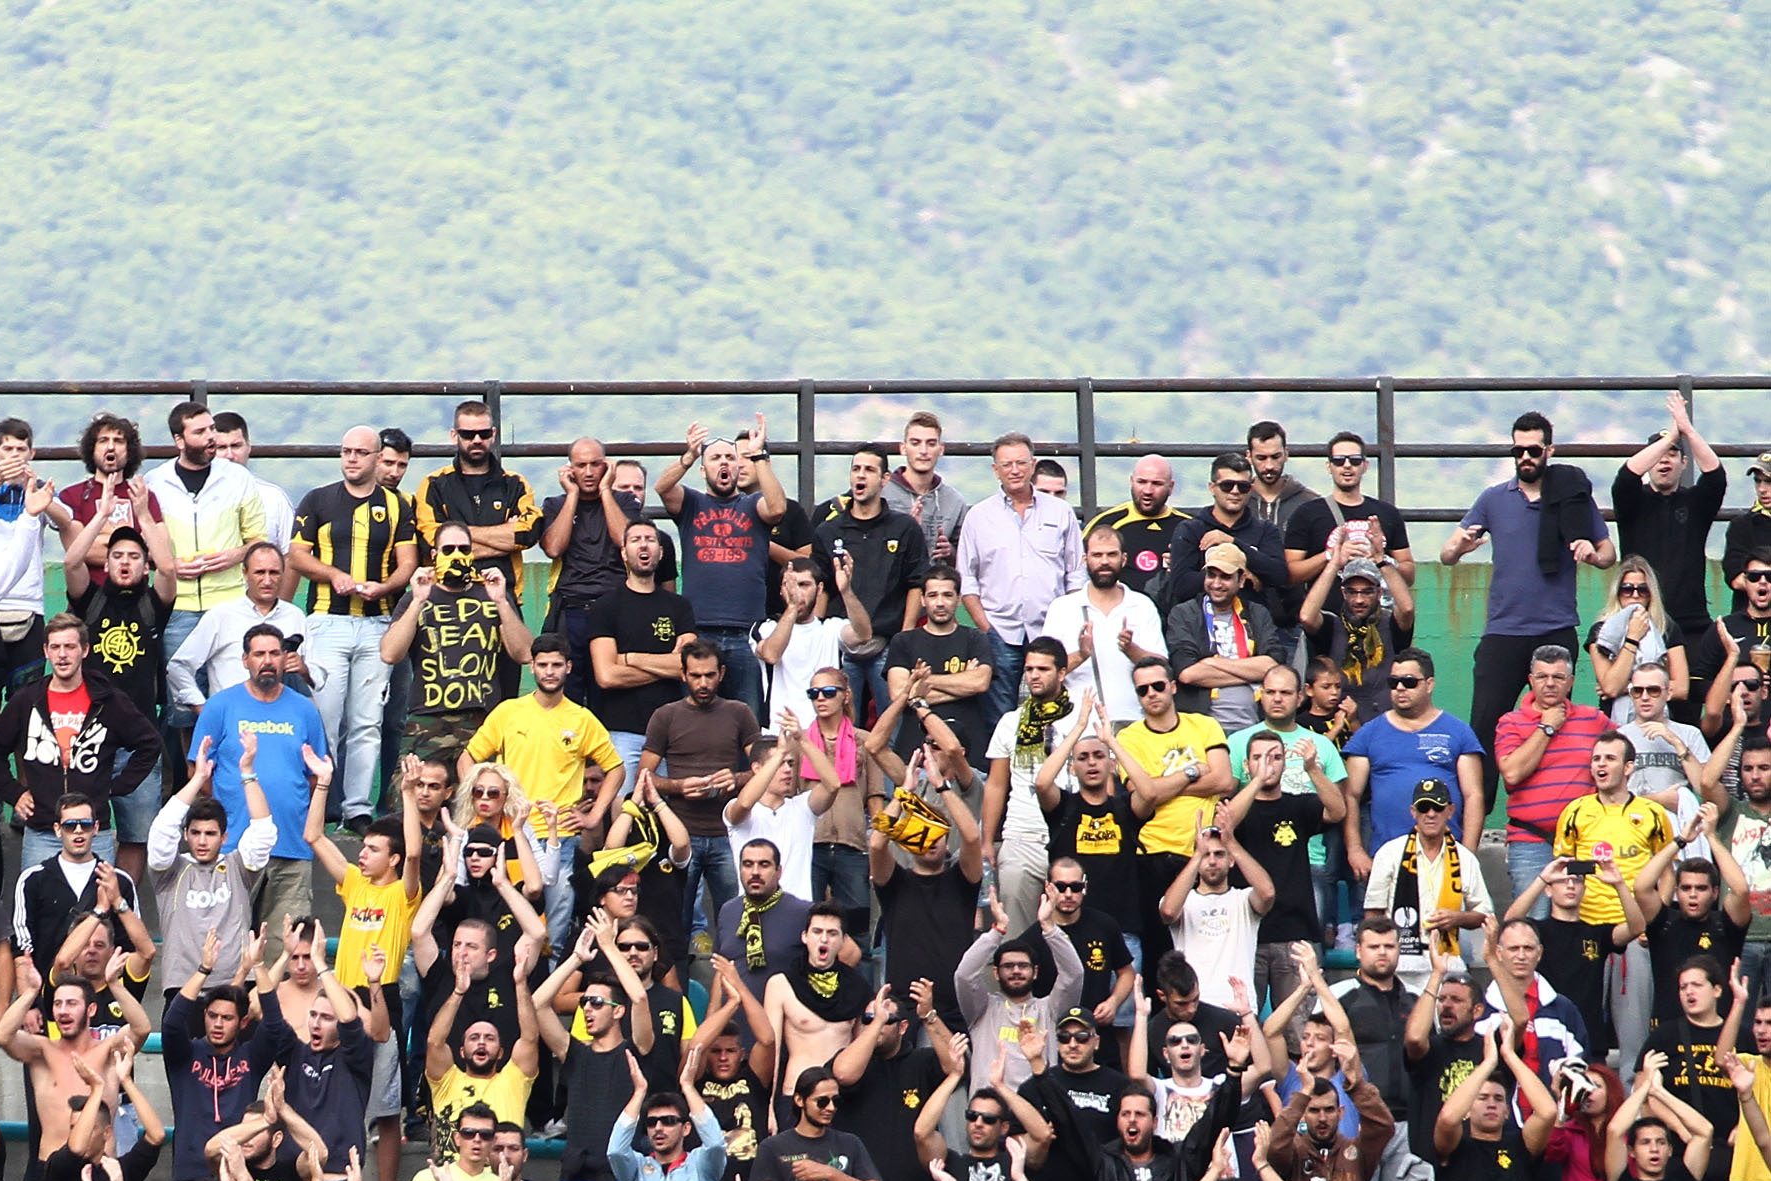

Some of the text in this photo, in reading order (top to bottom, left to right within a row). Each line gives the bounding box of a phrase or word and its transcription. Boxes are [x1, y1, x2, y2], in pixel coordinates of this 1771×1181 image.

[238, 719, 294, 736] Reebok
[1632, 753, 1683, 768] ETALLI
[1619, 845, 1638, 858] LG
[998, 1024, 1021, 1044] PU
[1673, 1073, 1735, 1090] PRONERS
